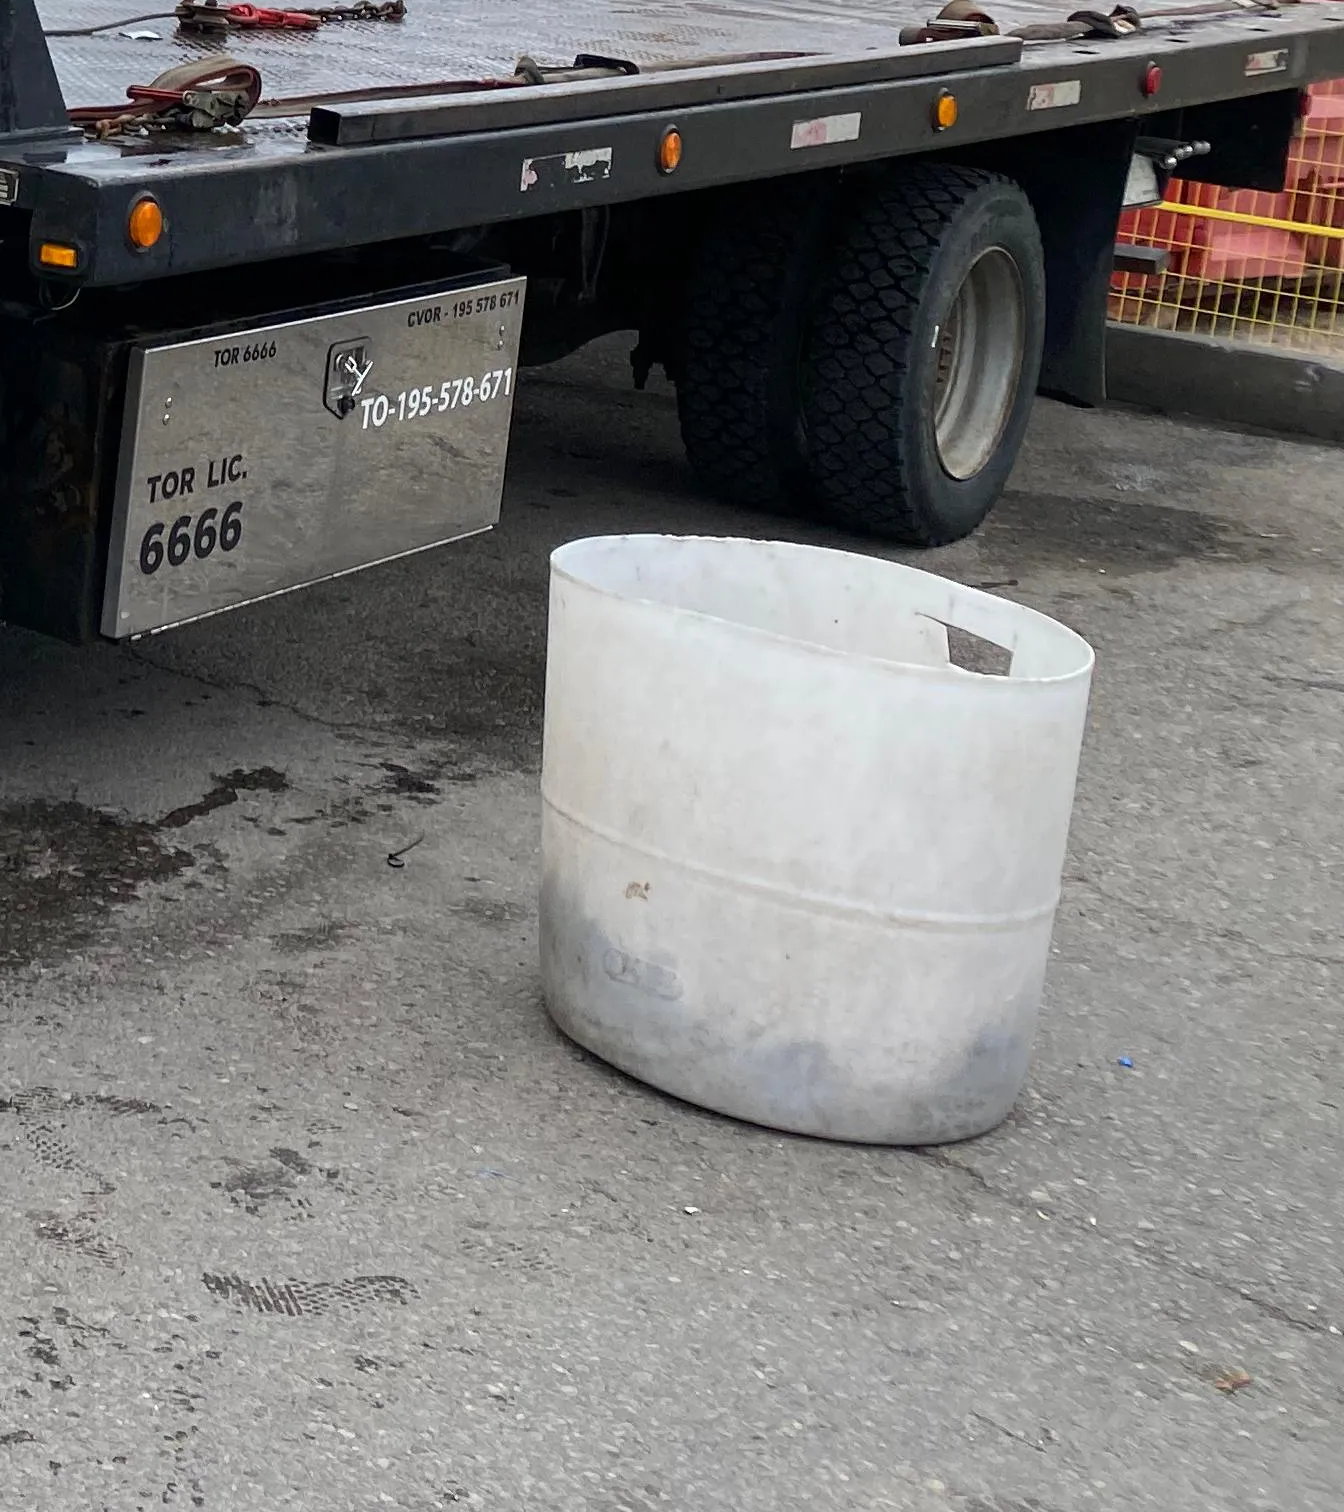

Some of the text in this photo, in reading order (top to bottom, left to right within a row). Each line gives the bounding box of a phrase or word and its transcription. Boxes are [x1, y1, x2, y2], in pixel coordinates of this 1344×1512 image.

[407, 306, 442, 328] CVOR
[452, 299, 473, 319] 195
[475, 294, 497, 314] 578
[499, 289, 520, 308] 671
[214, 341, 277, 368] TOR 6666
[360, 367, 513, 430] TO-195-578-671
[147, 454, 248, 504] TOR LIC.
[139, 501, 244, 576] 6666
